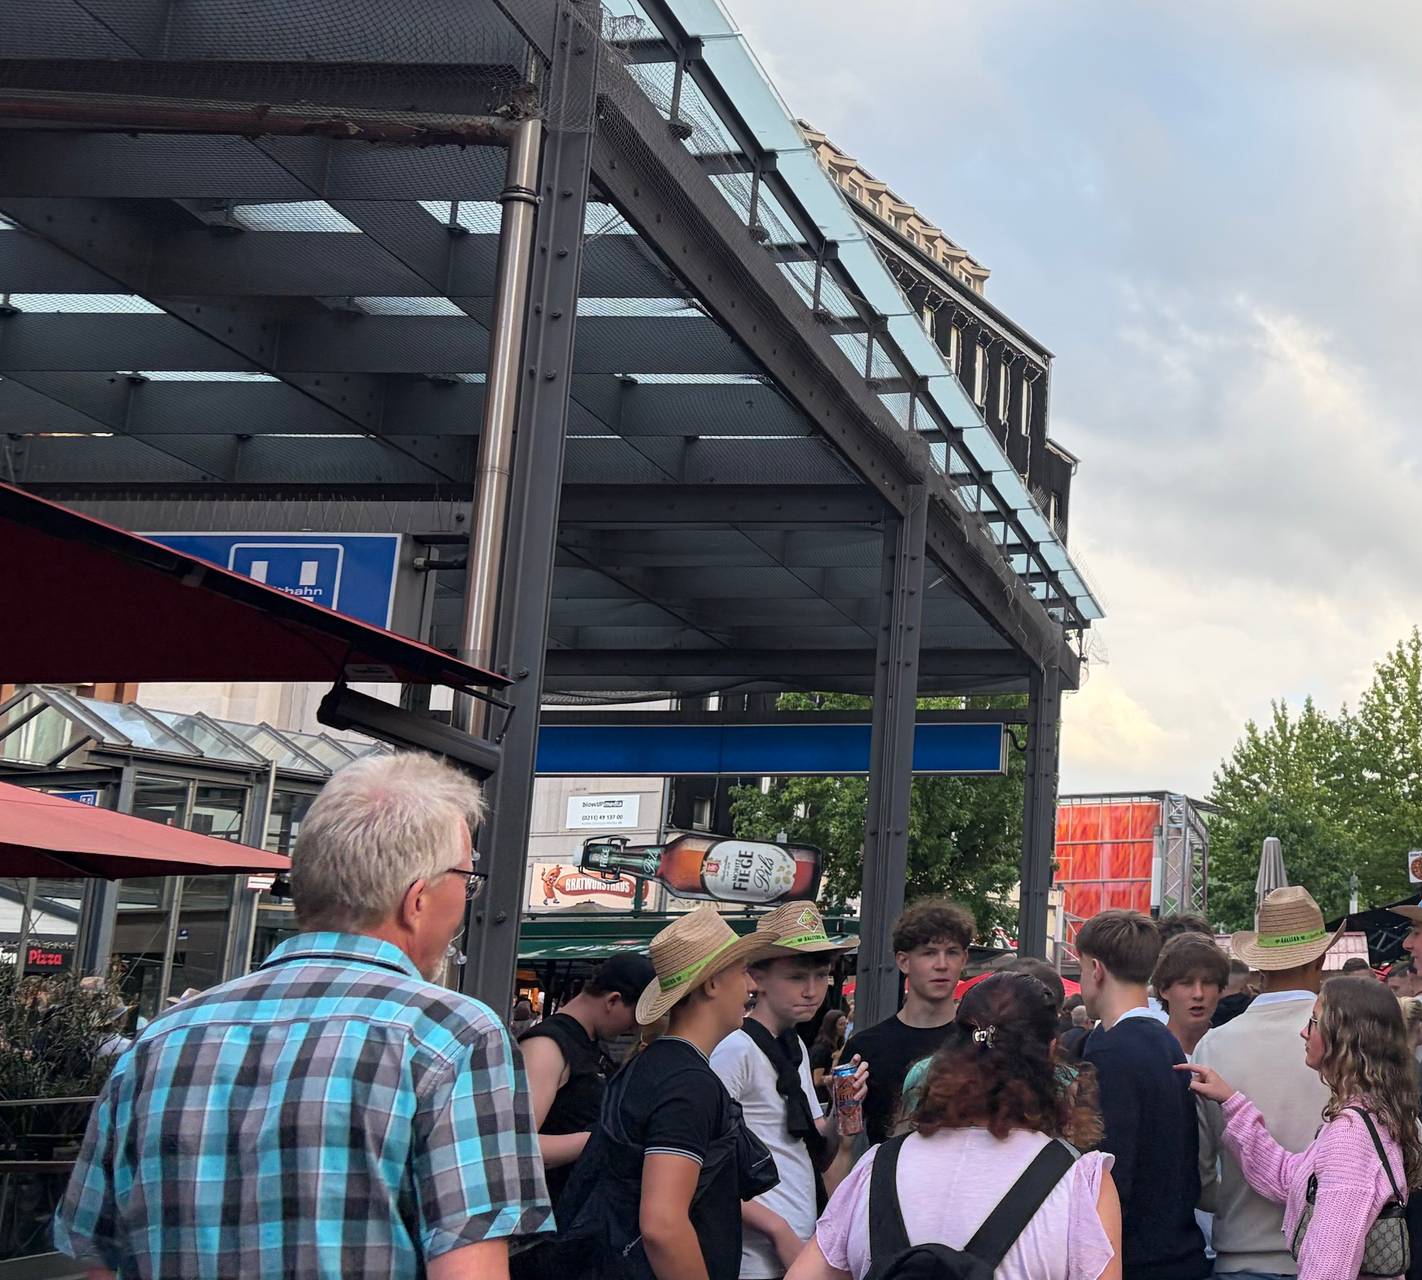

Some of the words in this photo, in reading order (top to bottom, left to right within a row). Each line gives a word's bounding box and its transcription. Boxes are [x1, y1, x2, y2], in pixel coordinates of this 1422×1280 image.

[732, 850, 754, 891] FIEGE
[753, 854, 775, 893] Pils
[28, 949, 63, 965] Pizza
